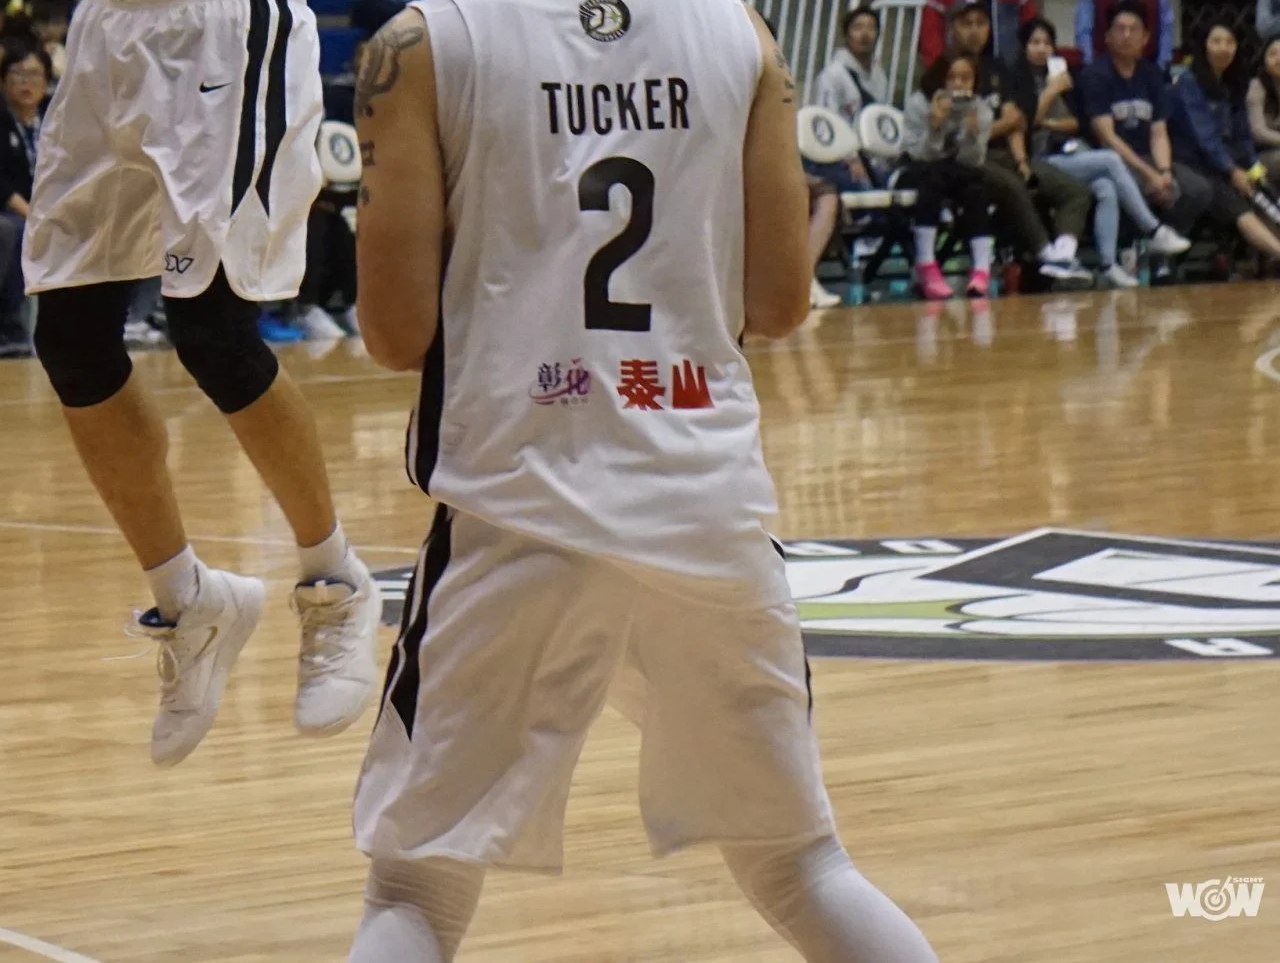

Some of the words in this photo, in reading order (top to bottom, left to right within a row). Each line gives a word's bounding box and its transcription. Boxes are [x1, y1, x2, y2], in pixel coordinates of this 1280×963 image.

[540, 77, 691, 136] TUCKER
[577, 155, 655, 332] 2
[616, 358, 717, 411] 泰山
